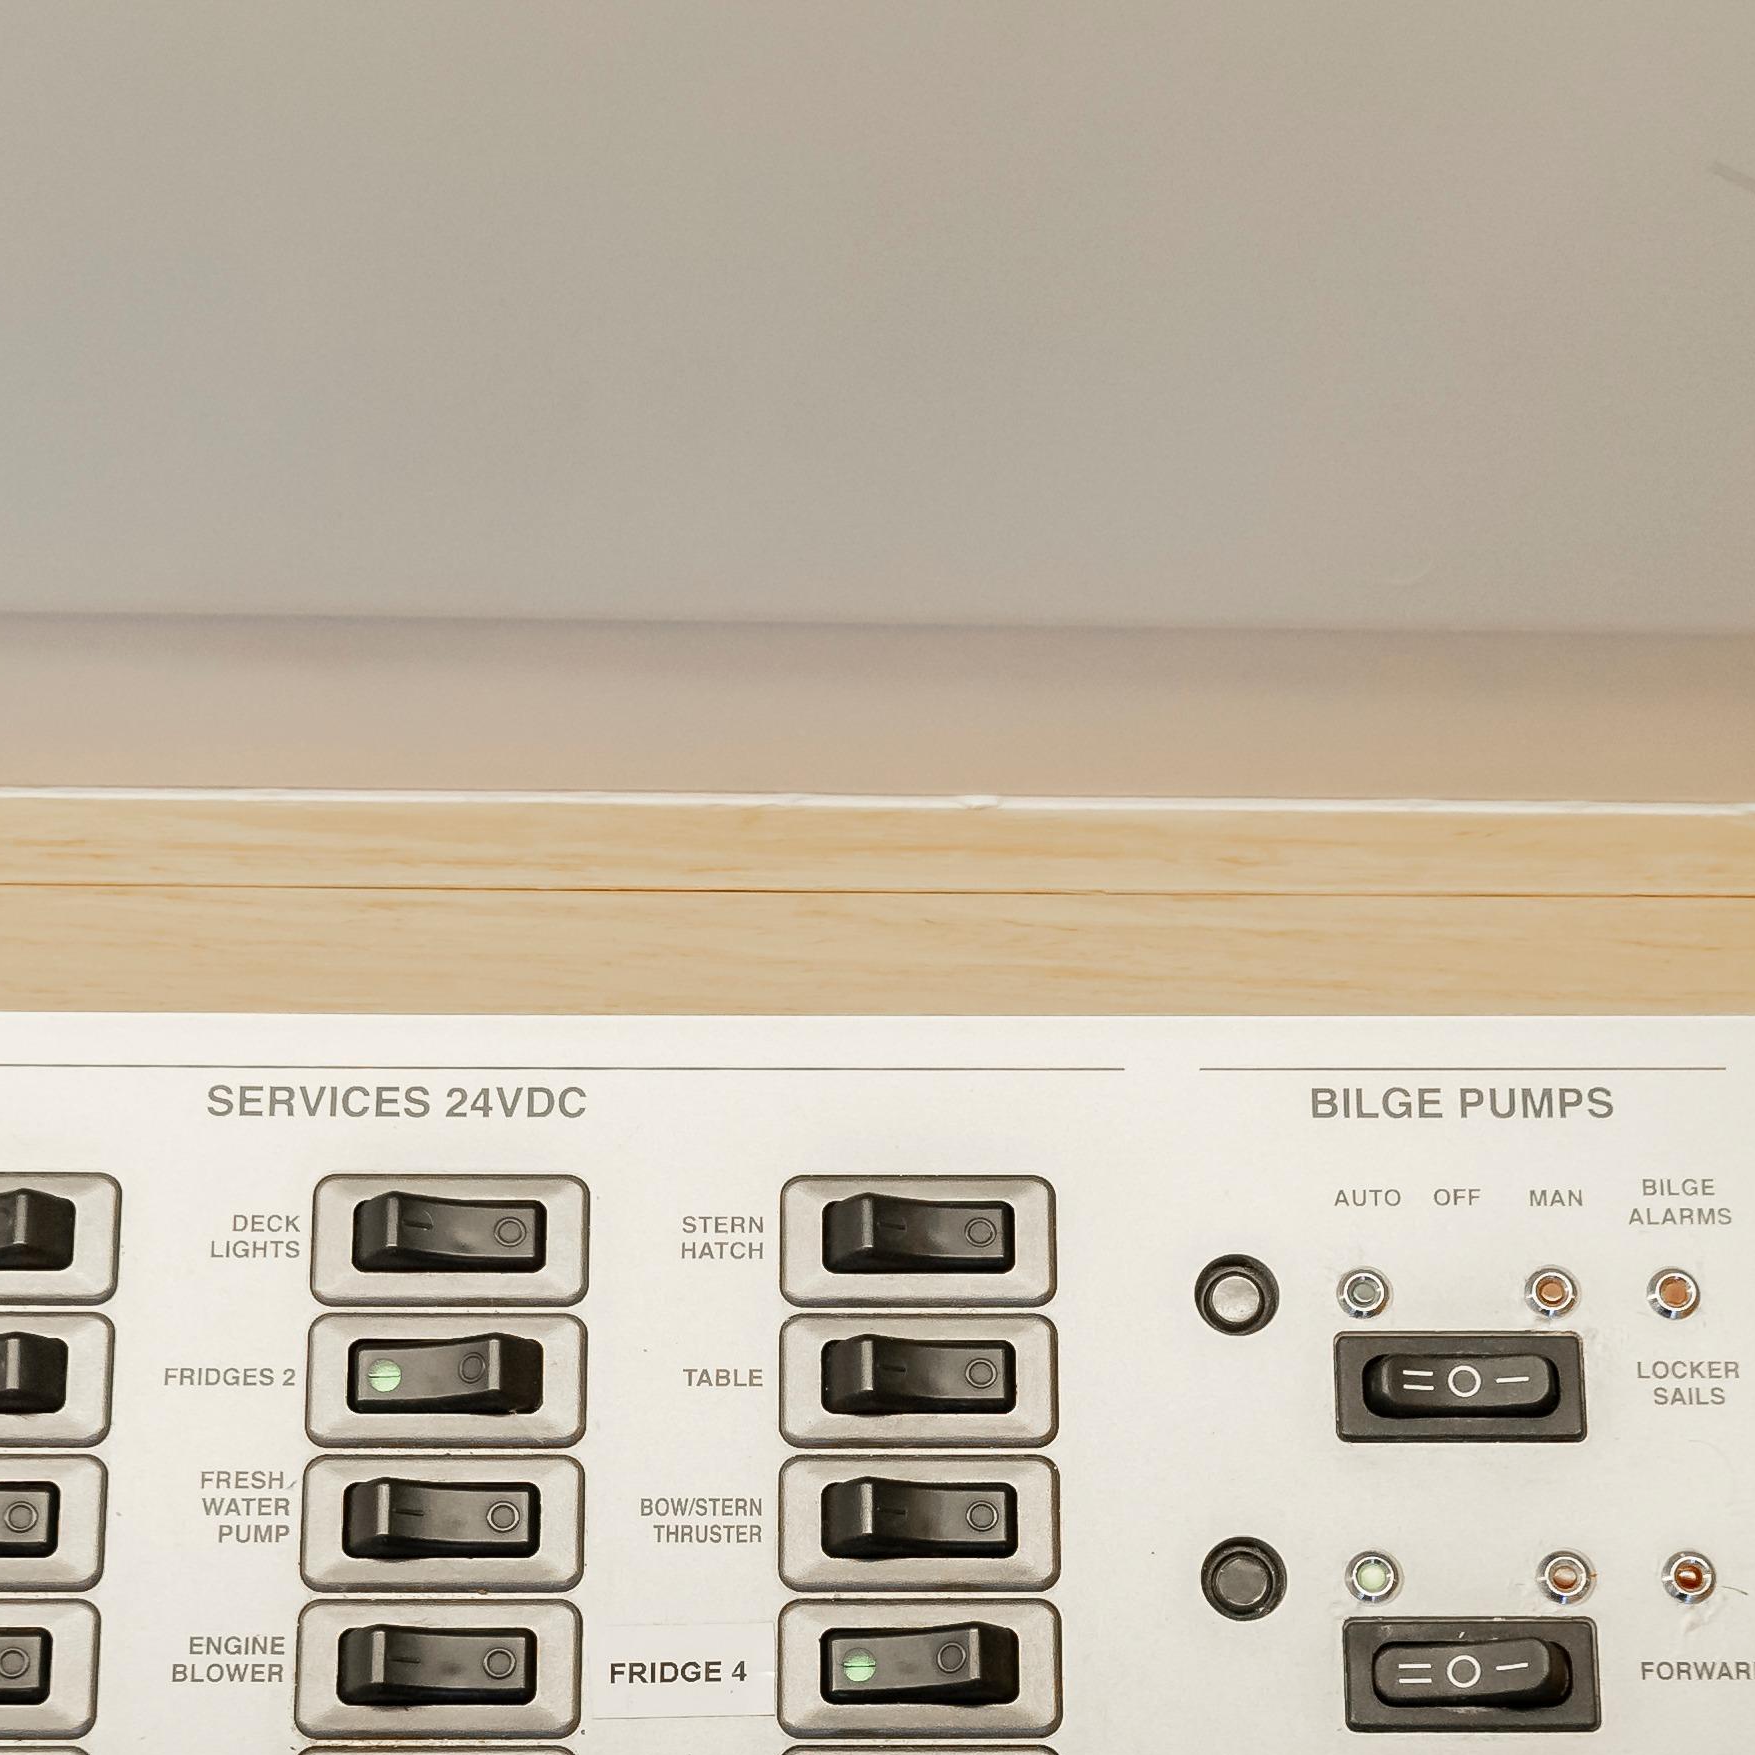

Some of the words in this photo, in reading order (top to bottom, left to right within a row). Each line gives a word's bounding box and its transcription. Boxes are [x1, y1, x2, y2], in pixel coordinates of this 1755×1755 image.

[207, 1084, 431, 1119] SERVICES
[445, 1086, 587, 1119] 24VDC
[1311, 1086, 1444, 1119] BILGE
[1459, 1086, 1614, 1119] PUMPS
[1334, 1188, 1402, 1207] AUTO
[1433, 1188, 1481, 1207] OFF
[1642, 1178, 1716, 1197] BILGE
[1529, 1189, 1583, 1207] MAN
[232, 1214, 301, 1233] DECK
[682, 1215, 764, 1234] STERN
[1628, 1207, 1732, 1226] ALARMS
[210, 1240, 300, 1259] LIGHTS
[681, 1241, 764, 1260] HATCH
[163, 1367, 275, 1387] FRIDGES
[281, 1368, 296, 1387] 2
[682, 1368, 764, 1387] TABLE
[1636, 1360, 1740, 1380] LOCKER
[1653, 1386, 1726, 1406] SAILS
[200, 1470, 284, 1490] FRESH
[201, 1497, 290, 1517] WATER
[640, 1497, 763, 1517] BOW/STERN
[218, 1524, 290, 1544] PUMP
[652, 1523, 762, 1544] THRUSTER
[189, 1635, 286, 1656] ENGINE
[171, 1663, 284, 1683] BLOWER
[610, 1660, 722, 1684] FRIDGE
[731, 1660, 748, 1682] 4
